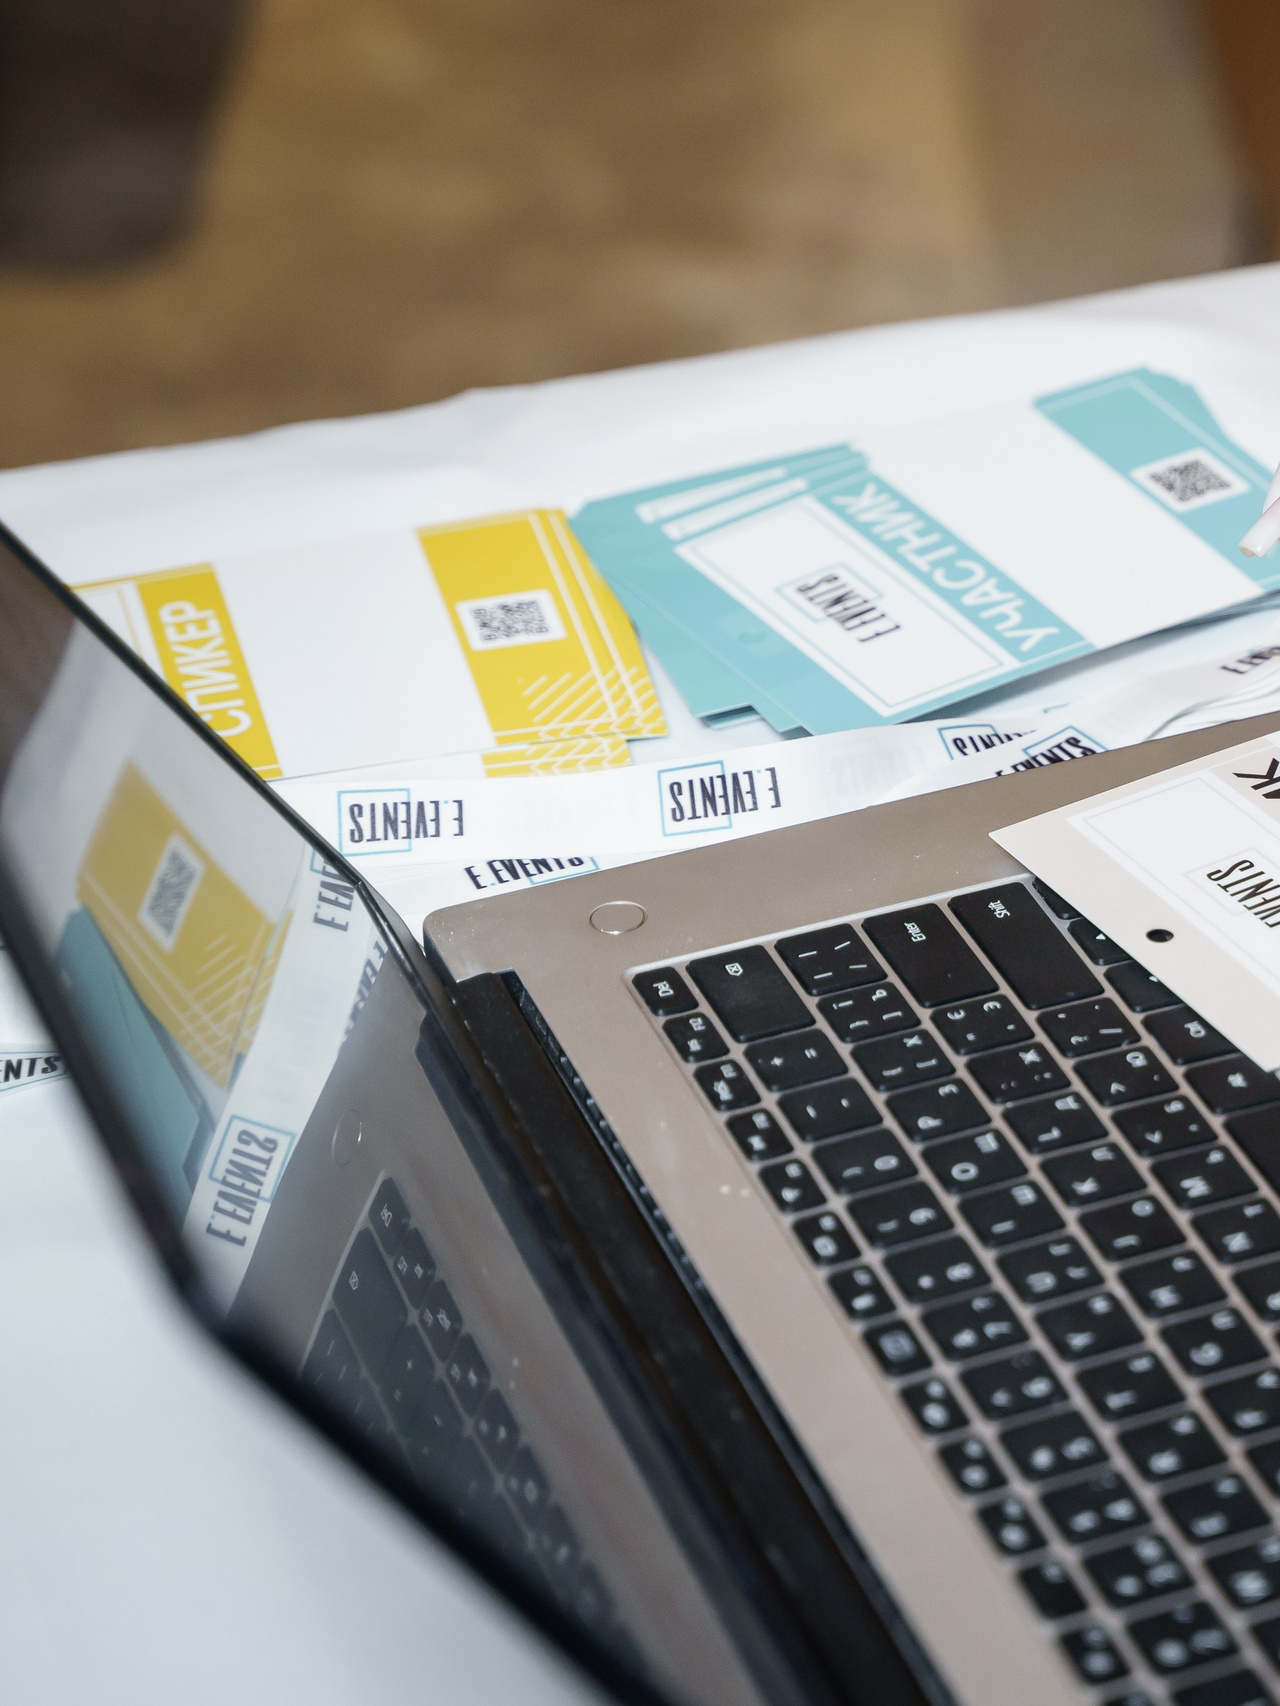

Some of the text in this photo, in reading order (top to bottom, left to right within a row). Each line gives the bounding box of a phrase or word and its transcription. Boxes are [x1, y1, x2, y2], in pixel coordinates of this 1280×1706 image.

[832, 482, 1060, 652] УЧАСТНИК
[158, 600, 252, 738] СПИКЕР
[349, 799, 465, 843] E.EVENTS
[669, 766, 782, 823] E.EVENTS
